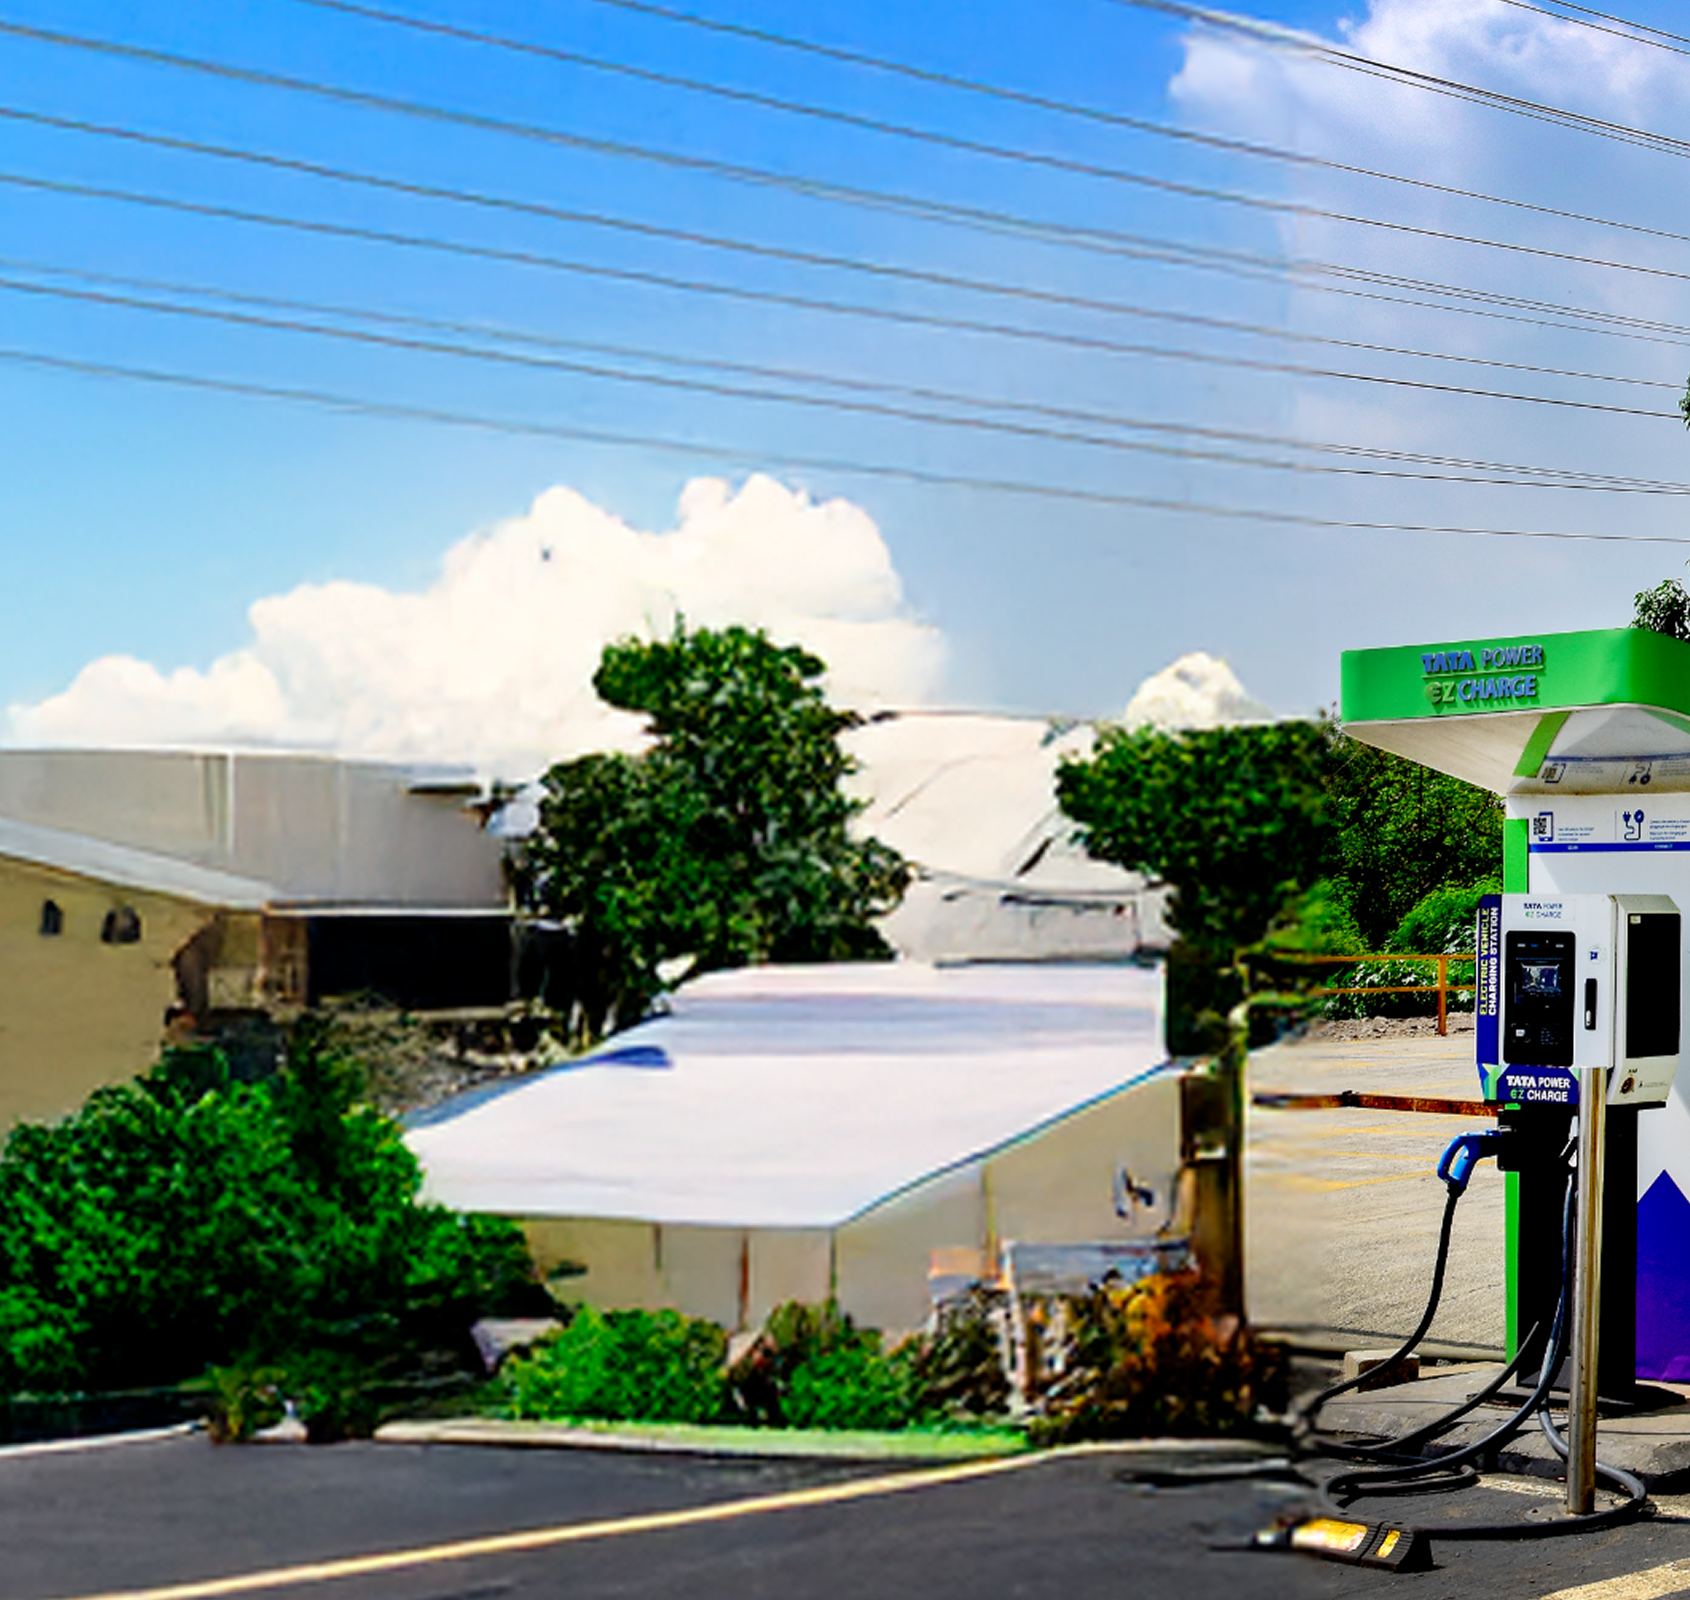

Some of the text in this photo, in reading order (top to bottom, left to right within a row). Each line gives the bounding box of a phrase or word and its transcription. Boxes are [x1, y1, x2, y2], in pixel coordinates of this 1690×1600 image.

[1421, 645, 1543, 673] TATA POWER
[1458, 675, 1537, 701] CHARGE
[1480, 908, 1490, 1015] ELECTRIC VEHICLE
[1488, 907, 1499, 1016] CHARGING STATION
[1506, 1075, 1571, 1089] TATA POWER
[1527, 1090, 1568, 1102] CHARGE
